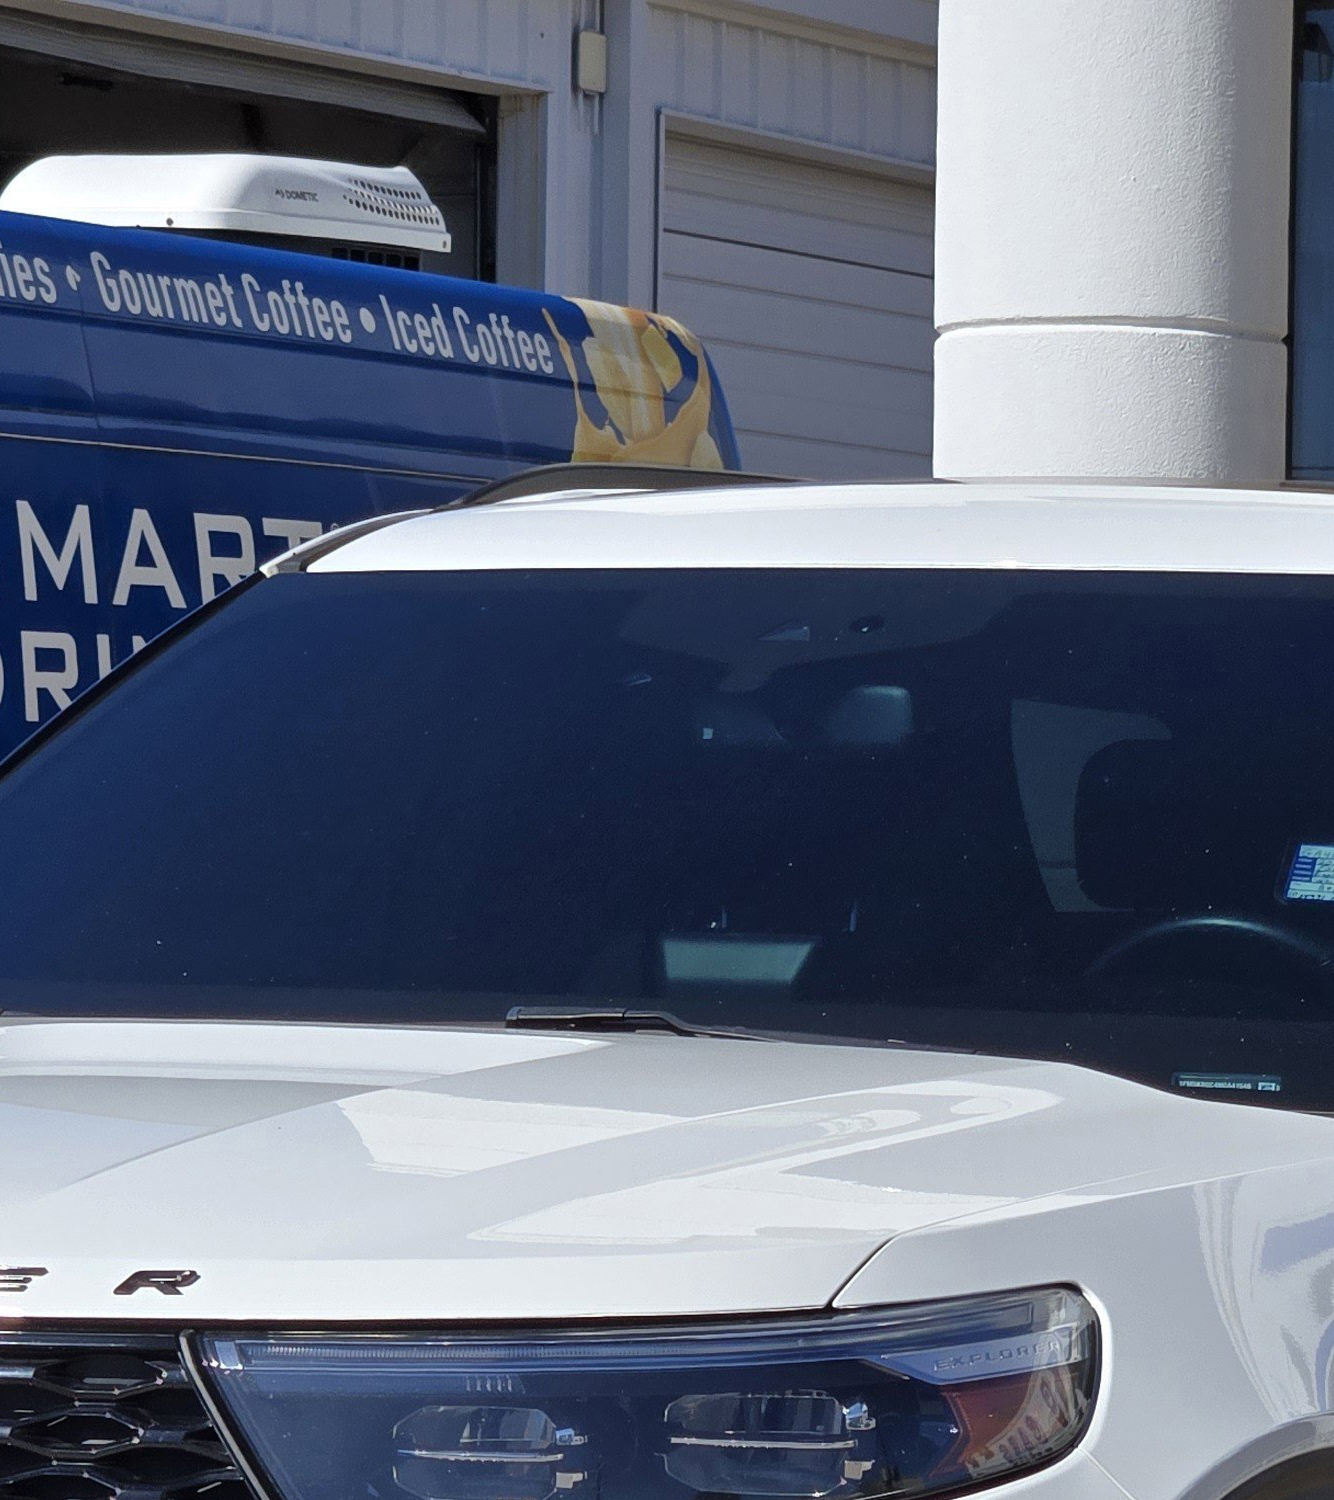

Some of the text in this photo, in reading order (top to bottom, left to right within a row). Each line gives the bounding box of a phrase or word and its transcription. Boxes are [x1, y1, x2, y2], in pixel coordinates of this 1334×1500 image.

[89, 250, 244, 329] Gourmet
[239, 272, 353, 344] Coffee
[378, 293, 455, 359] Iced
[452, 306, 555, 375] Coffee
[932, 1340, 1061, 1373] EXPLORER
